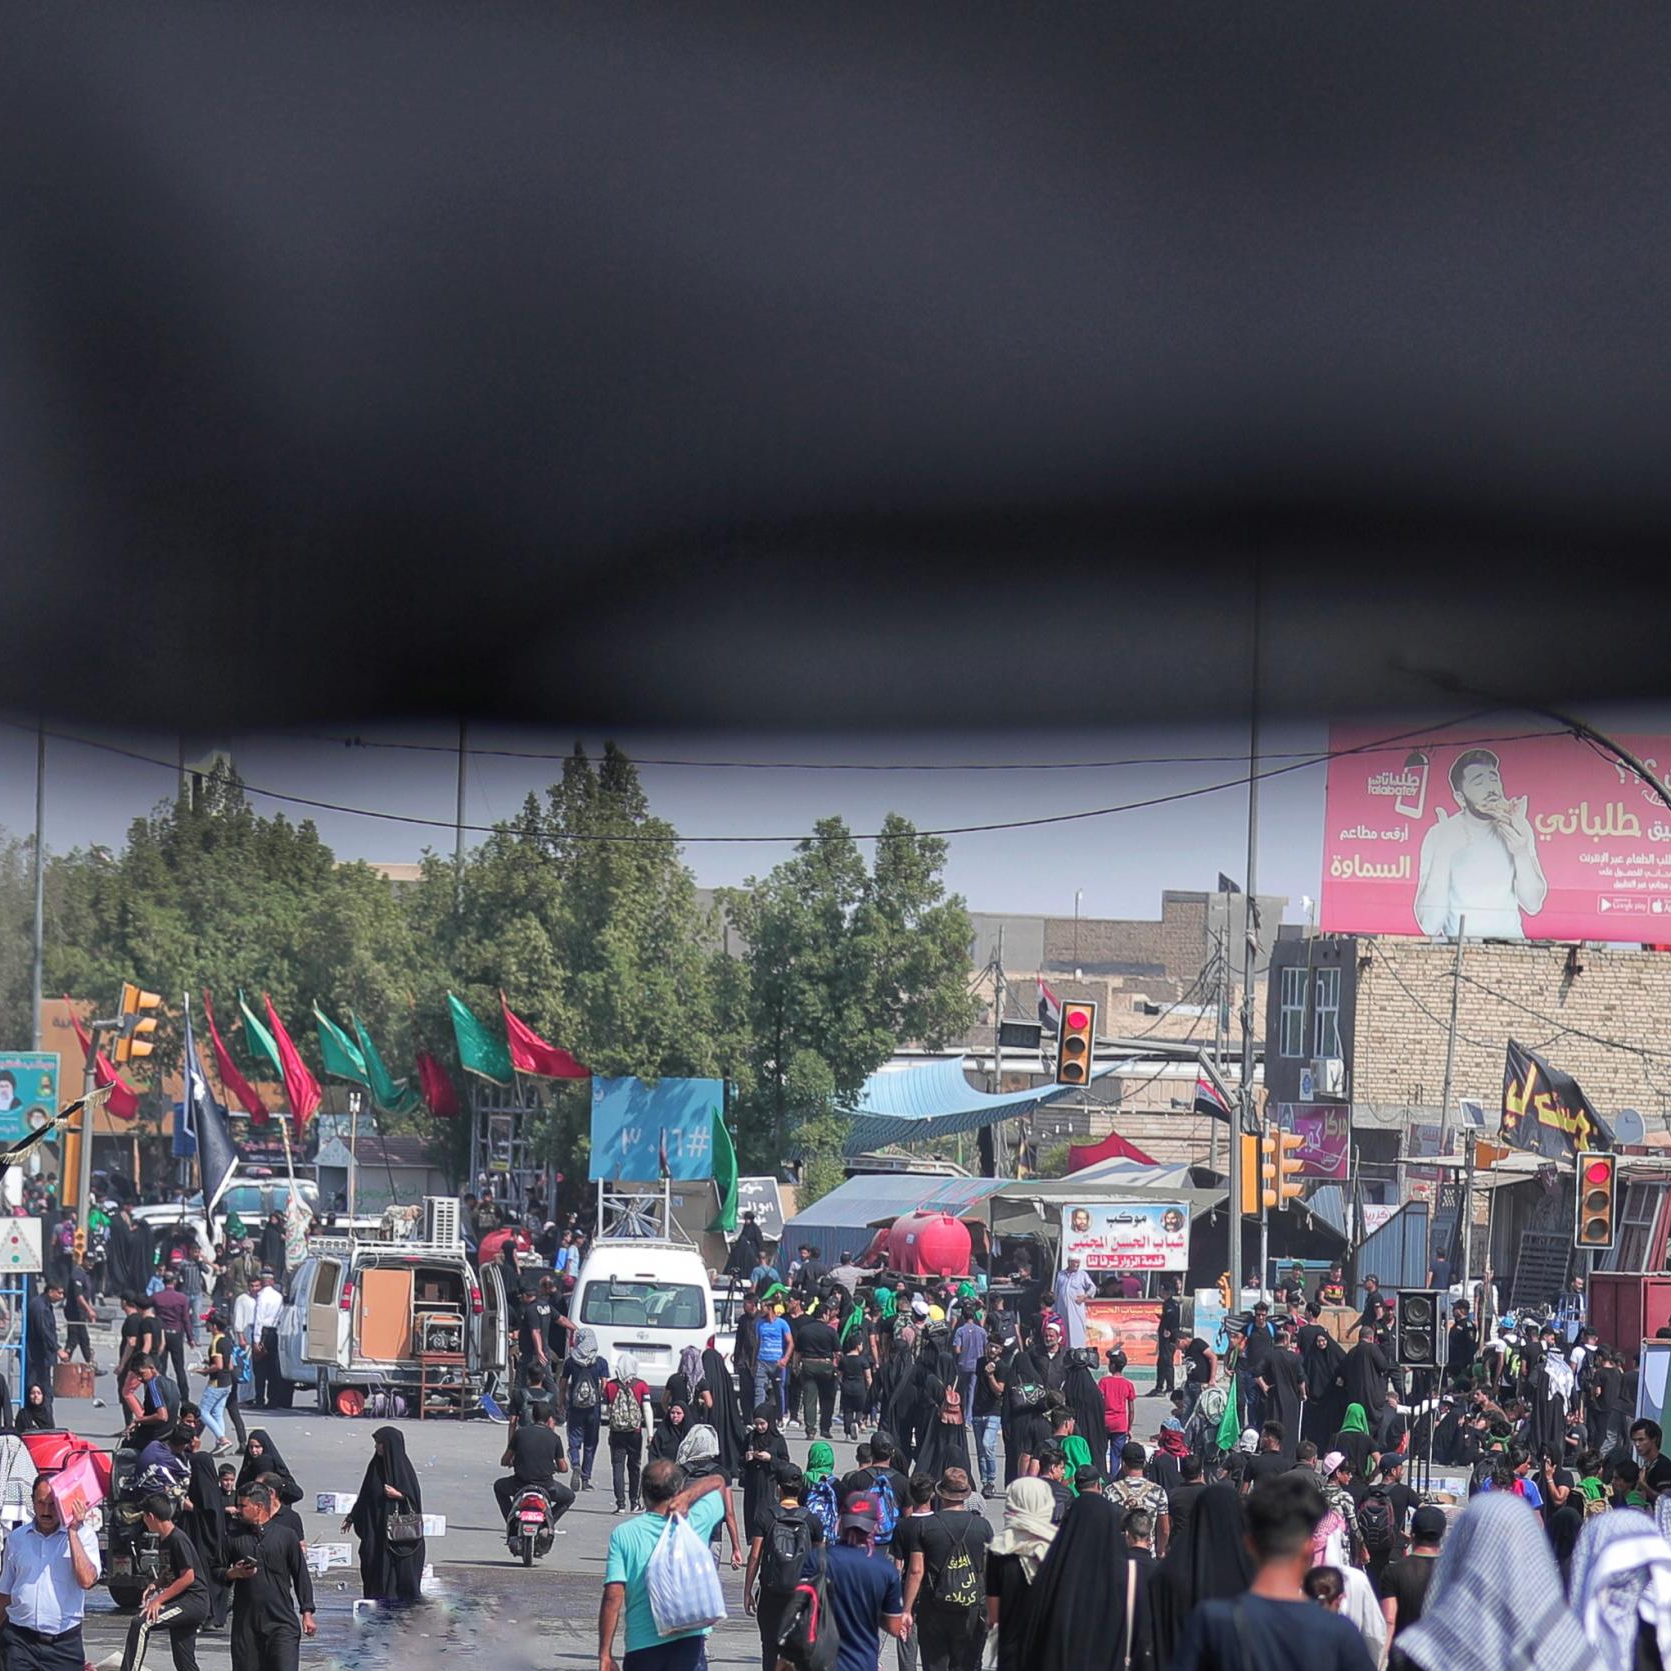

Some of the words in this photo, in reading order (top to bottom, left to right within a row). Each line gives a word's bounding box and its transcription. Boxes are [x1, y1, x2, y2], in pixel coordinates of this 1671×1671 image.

[1535, 802, 1642, 842] طلباتي
[1340, 825, 1377, 840] مطاعم
[1381, 823, 1409, 842] أرقى
[1331, 854, 1411, 879] السماوة
[1106, 1211, 1147, 1228] موكب
[1111, 1234, 1150, 1252] الحسن
[1153, 1233, 1184, 1252] شباب
[1142, 1255, 1165, 1266] خدمة
[944, 1591, 977, 1606] كربلاء
